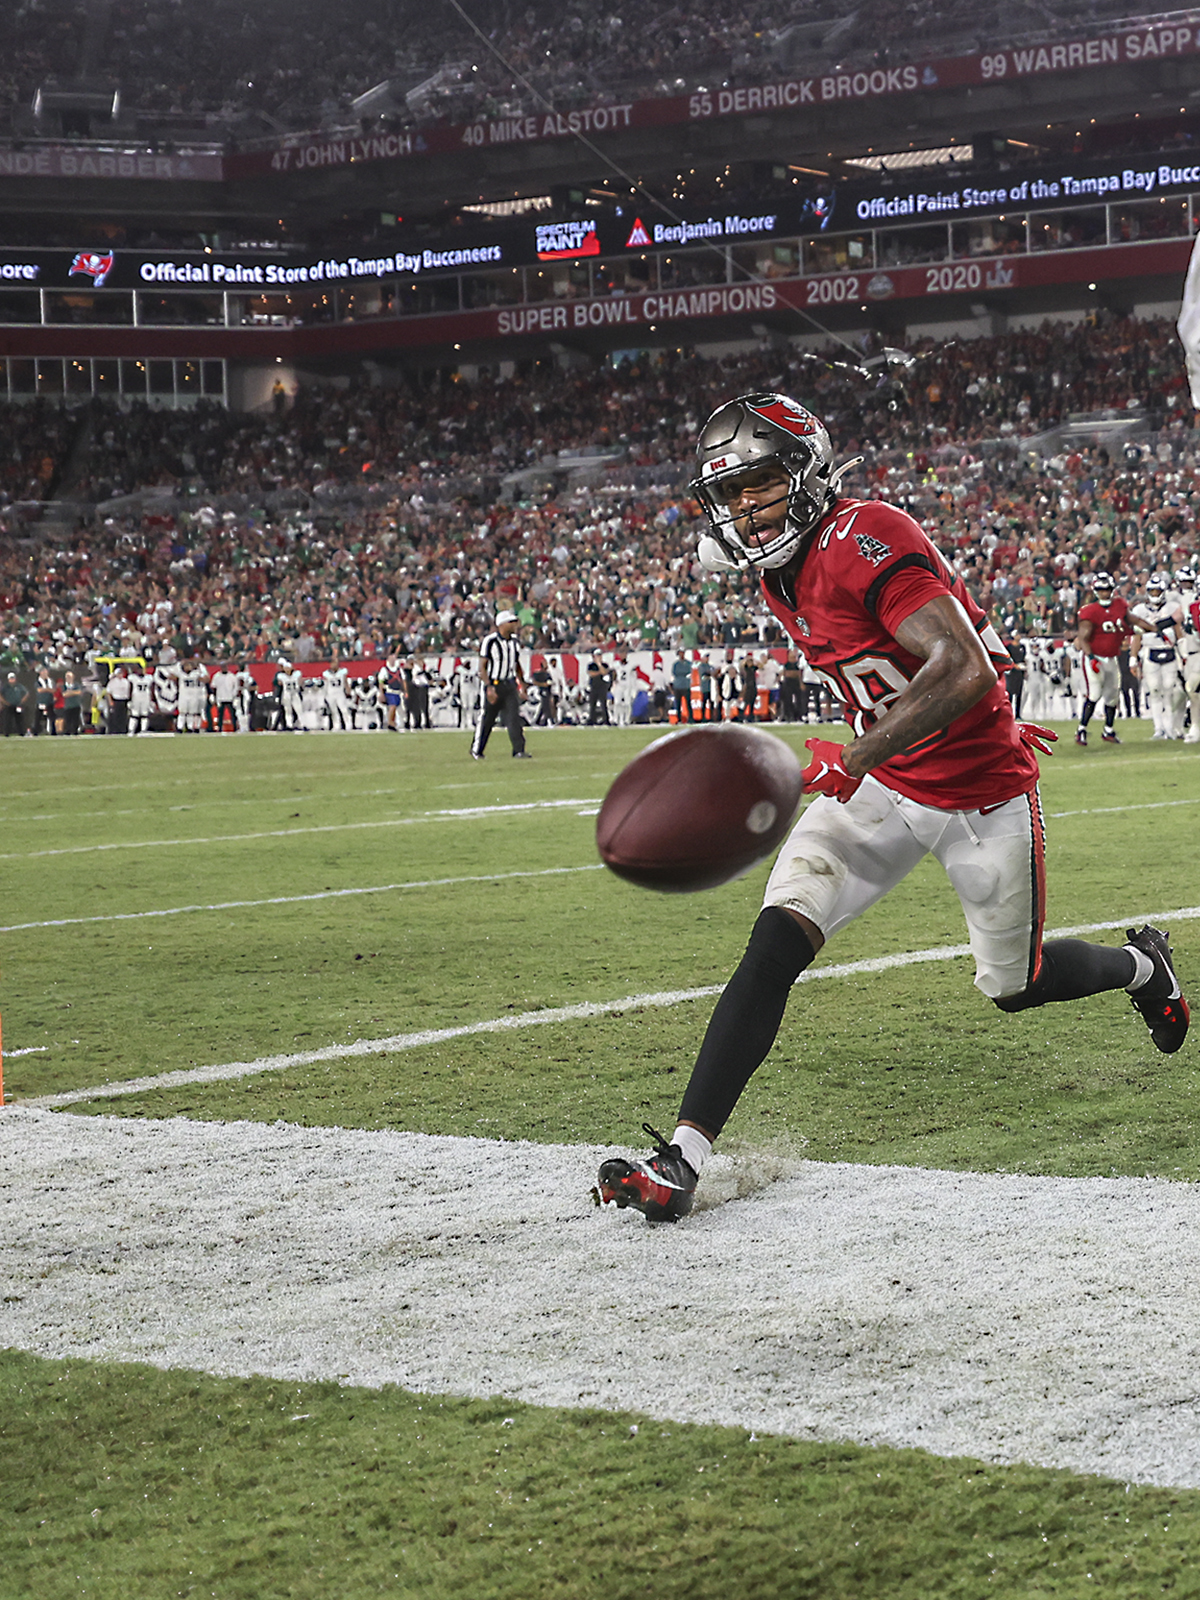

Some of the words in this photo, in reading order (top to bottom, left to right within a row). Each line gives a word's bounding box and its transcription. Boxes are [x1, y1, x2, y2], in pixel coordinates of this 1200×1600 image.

[981, 54, 1007, 78] 99
[1014, 38, 1118, 73] WARREN
[1126, 28, 1191, 59] SAPP
[689, 95, 712, 117] 55
[718, 80, 814, 113] DERRICK
[821, 66, 918, 100] BROOKS
[462, 126, 484, 147] 40
[489, 113, 537, 144] MIKE
[542, 104, 634, 136] ALSTOTT
[60, 155, 172, 178] BARBER
[271, 152, 290, 171] 47
[296, 142, 346, 169] JOHN
[350, 134, 412, 163] LYNCH
[857, 198, 914, 219] Official
[916, 194, 960, 213] Paint
[962, 186, 1007, 208] Store
[1010, 183, 1028, 200] of
[1031, 181, 1059, 198] the
[1061, 173, 1119, 196] Tampa
[1122, 168, 1157, 192] Bay
[535, 220, 596, 237] SPECTRUM
[536, 234, 585, 252] PAINT
[654, 219, 722, 246] Benjamin
[725, 214, 773, 235] Moore
[140, 261, 209, 283] Official
[212, 262, 264, 284] Paint
[265, 264, 308, 285] Store
[309, 259, 326, 278] of
[325, 257, 348, 277] the
[348, 252, 395, 276] Tampa
[396, 250, 422, 273] Bay
[423, 244, 501, 268] Buccaneers
[926, 264, 980, 292] 2020
[806, 278, 859, 304] 2002
[498, 305, 566, 334] SUPER
[574, 300, 637, 328] BOWL
[642, 286, 777, 319] CHAMPIONS
